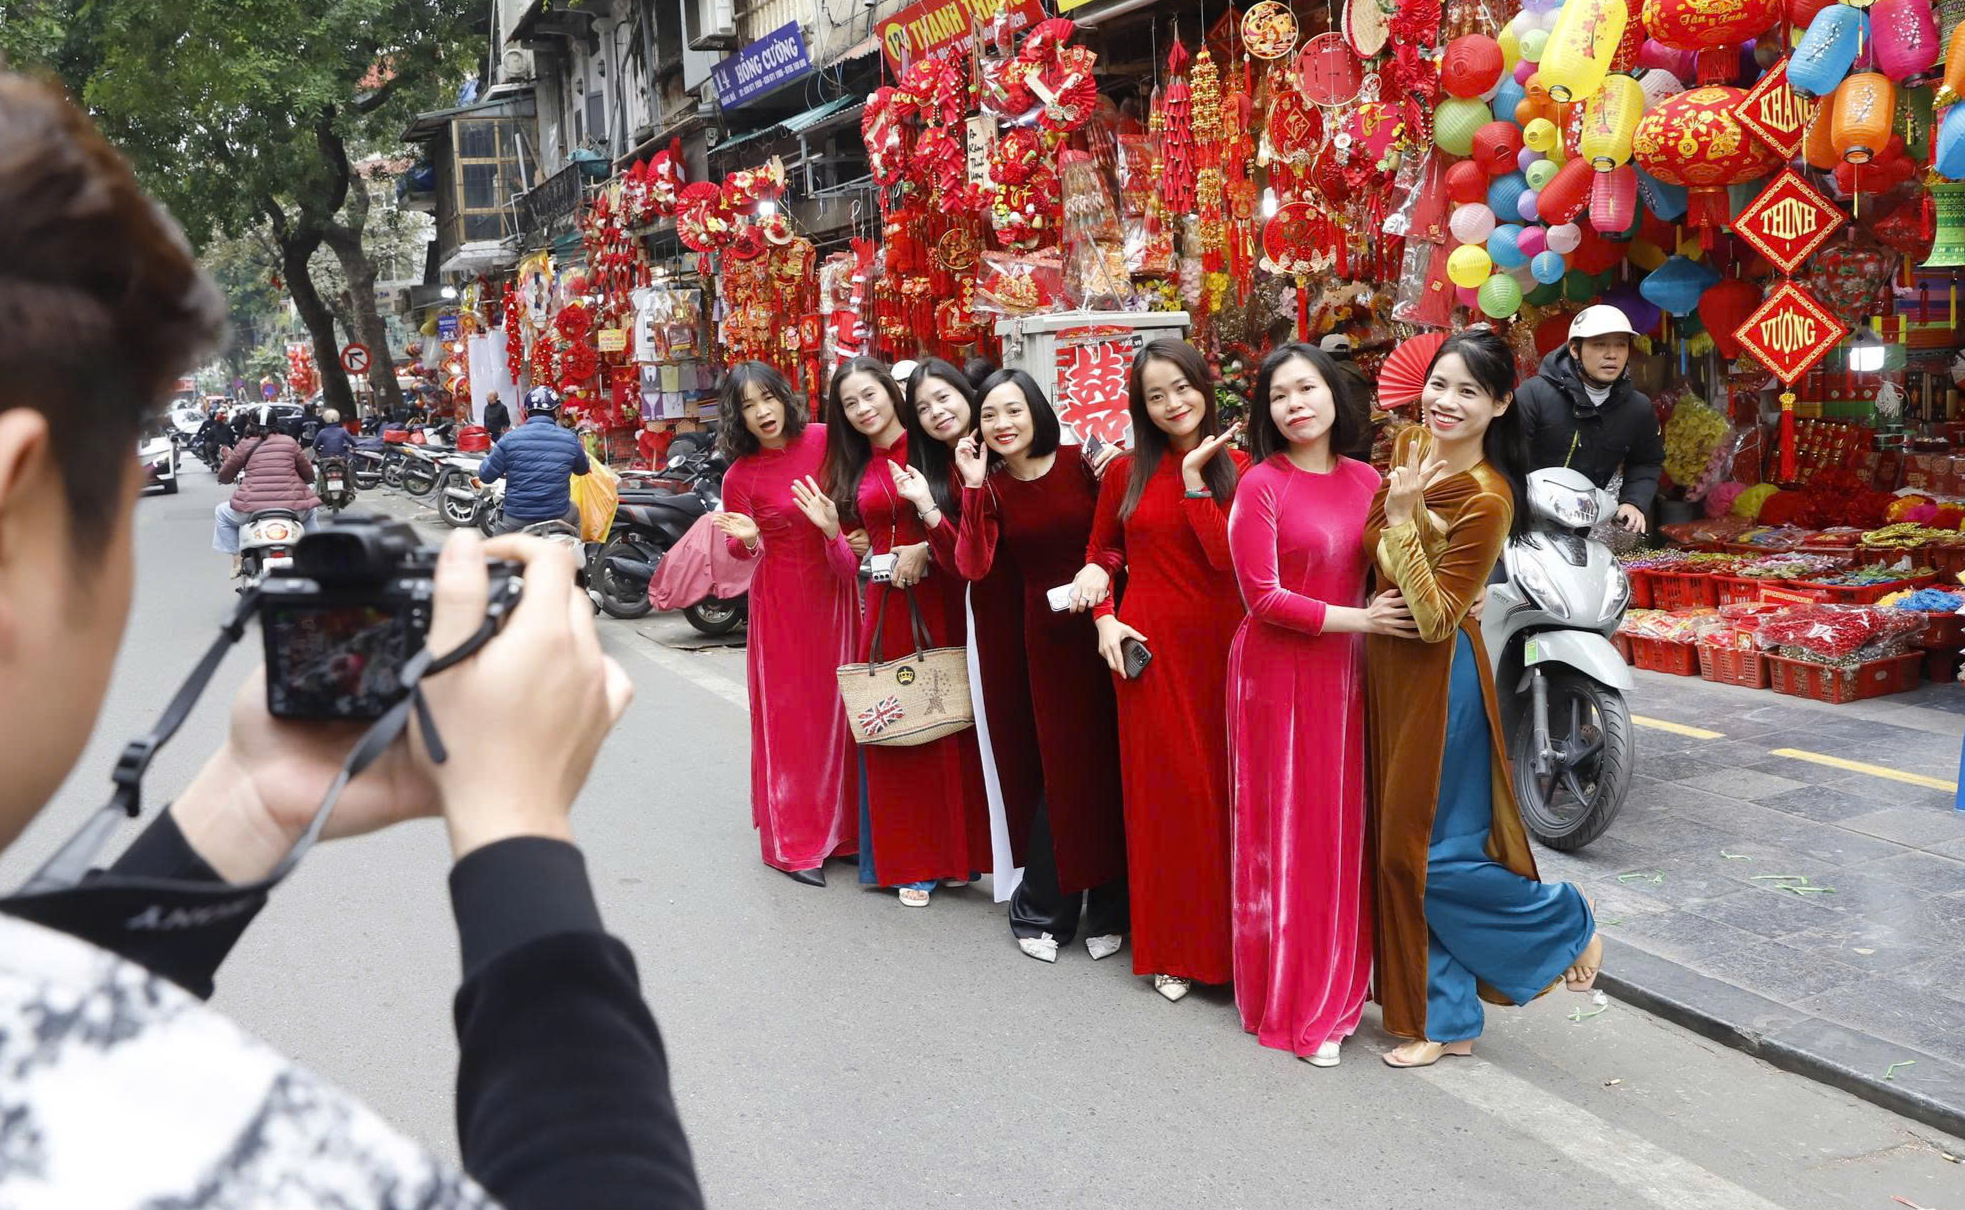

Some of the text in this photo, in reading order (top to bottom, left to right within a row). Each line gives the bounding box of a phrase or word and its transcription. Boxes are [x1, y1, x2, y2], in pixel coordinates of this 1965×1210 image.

[908, 3, 966, 51] THANH
[735, 51, 763, 84] HỒNG
[762, 37, 798, 70] CƯỜNG
[1760, 82, 1815, 133] KHANG
[1760, 197, 1816, 251] THỊNH
[1760, 306, 1816, 364] VƯỢNG
